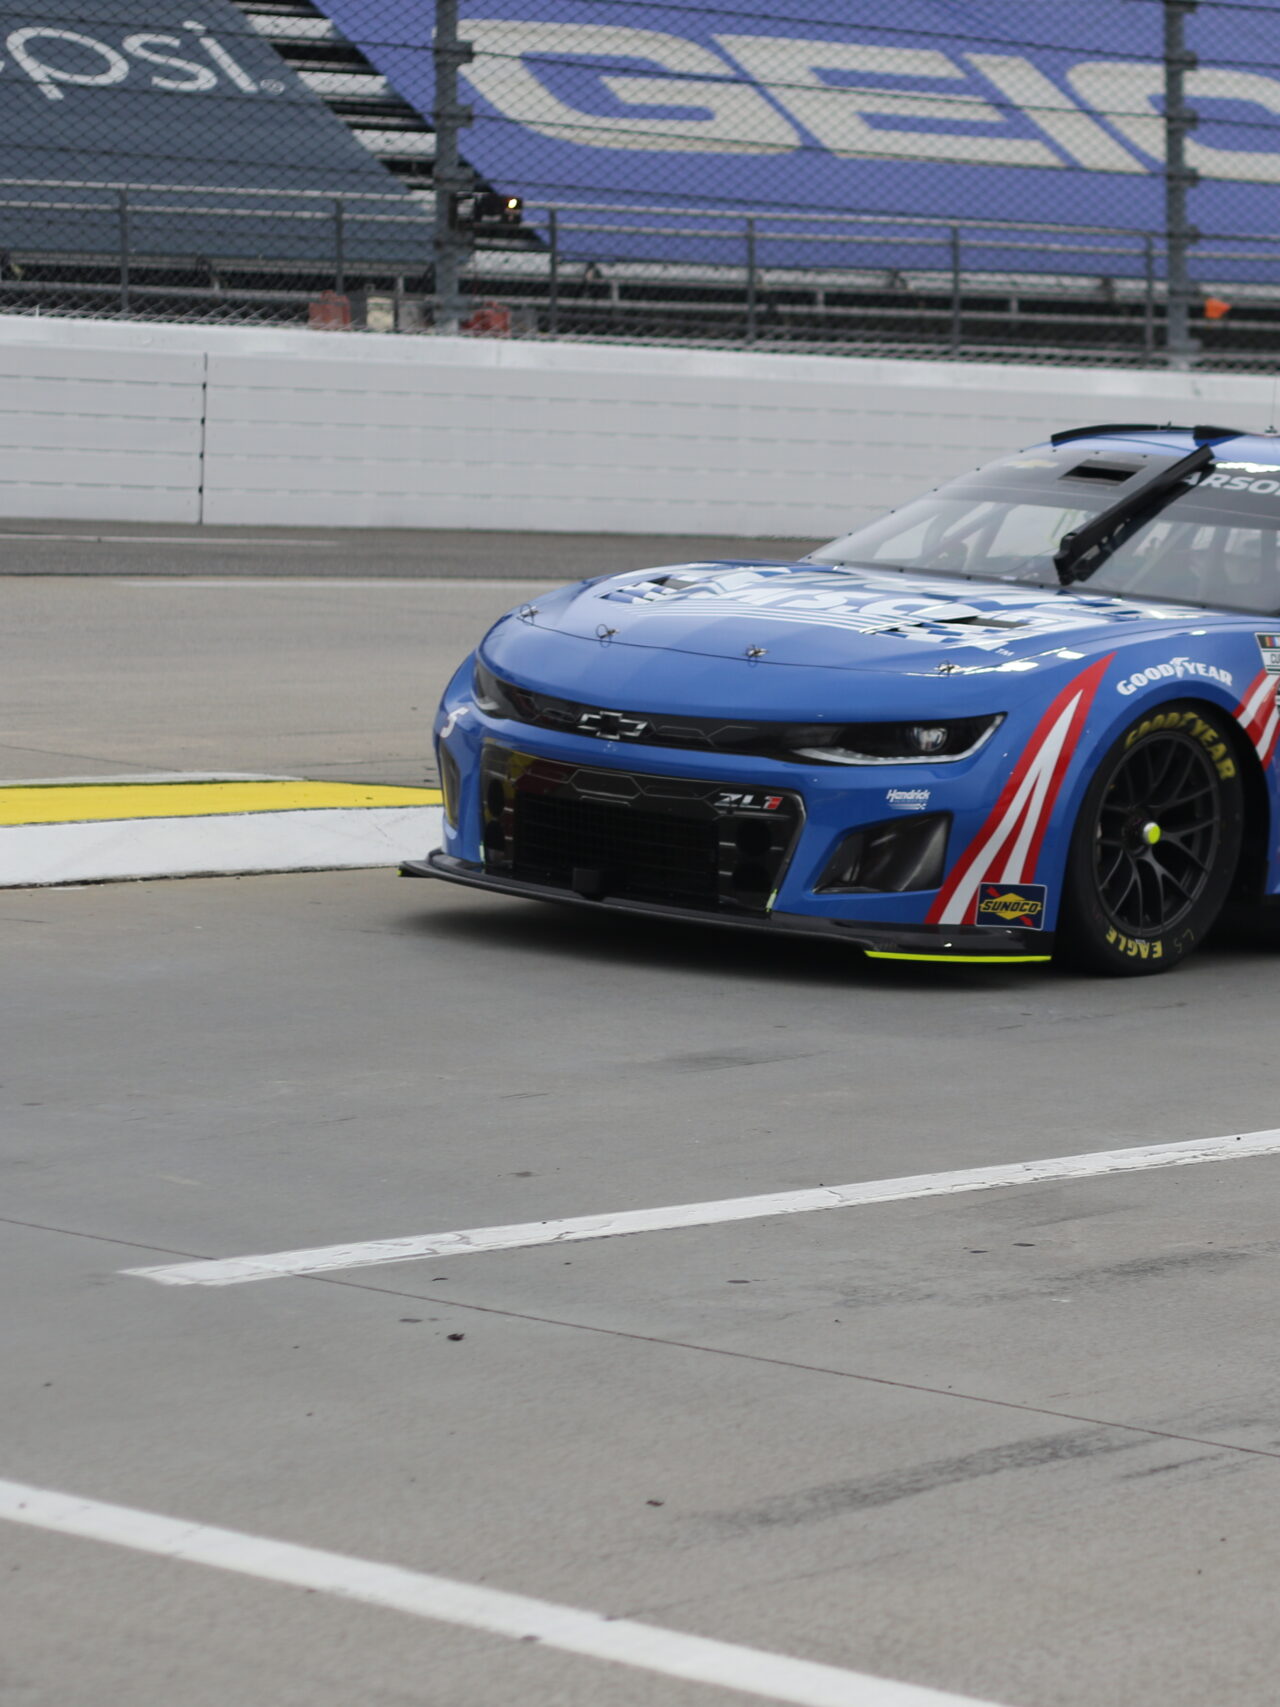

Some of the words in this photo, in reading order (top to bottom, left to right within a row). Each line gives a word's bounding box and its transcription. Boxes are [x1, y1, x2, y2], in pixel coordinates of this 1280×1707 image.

[0, 20, 258, 99] psi
[1116, 656, 1233, 695] GOODYEAR
[714, 792, 784, 810] ZL1
[886, 788, 931, 802] Hendrick
[982, 900, 1040, 913] SUNOCO
[1105, 925, 1164, 959] EAGLE
